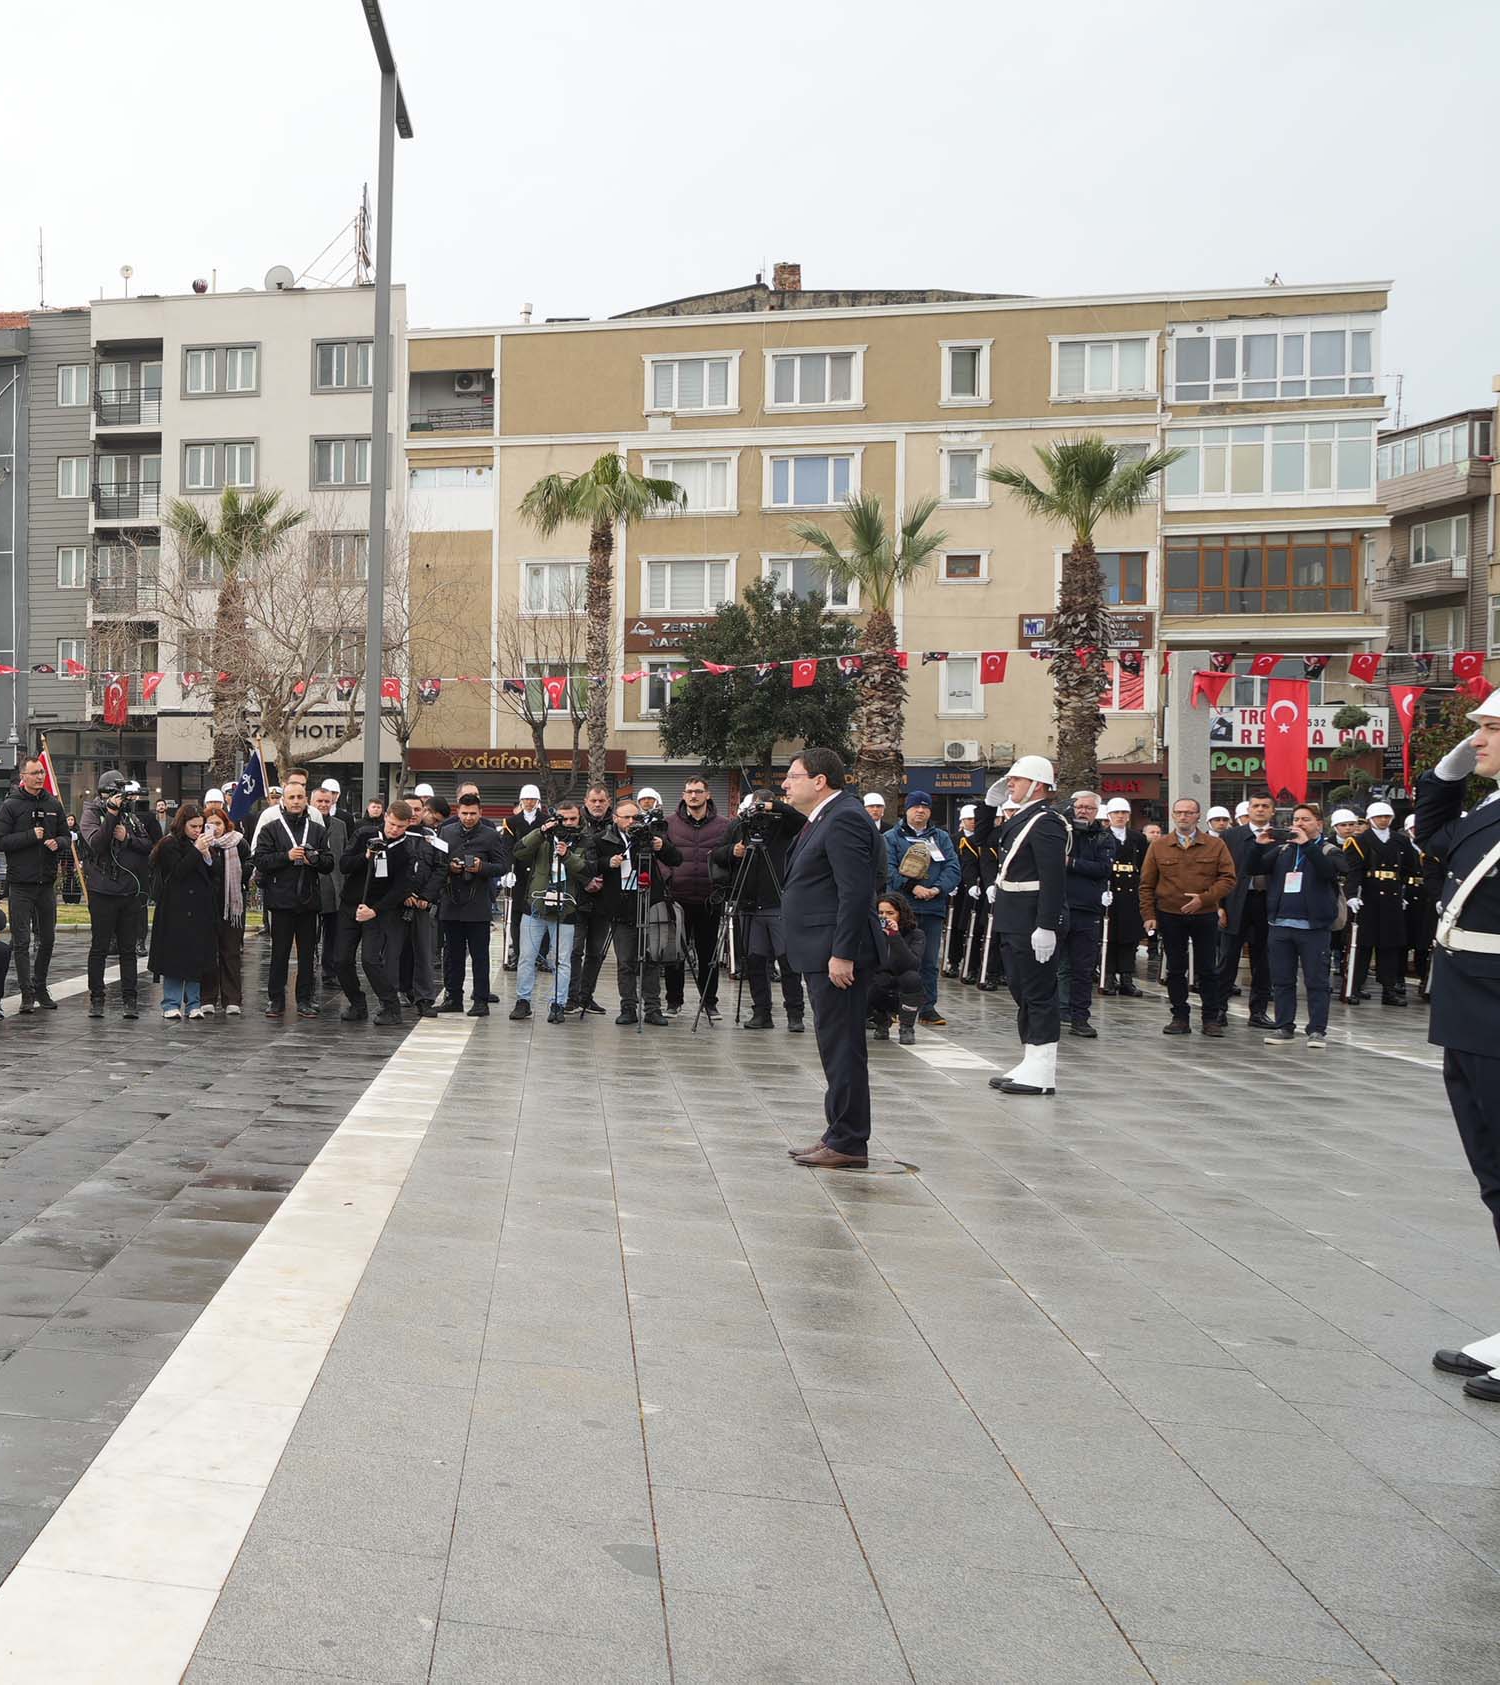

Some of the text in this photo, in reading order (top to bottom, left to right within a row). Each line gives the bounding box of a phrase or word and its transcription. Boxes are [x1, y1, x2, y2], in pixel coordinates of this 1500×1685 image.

[295, 724, 346, 738] HOTE
[1312, 729, 1324, 745] A
[1102, 779, 1143, 792] SAAT
